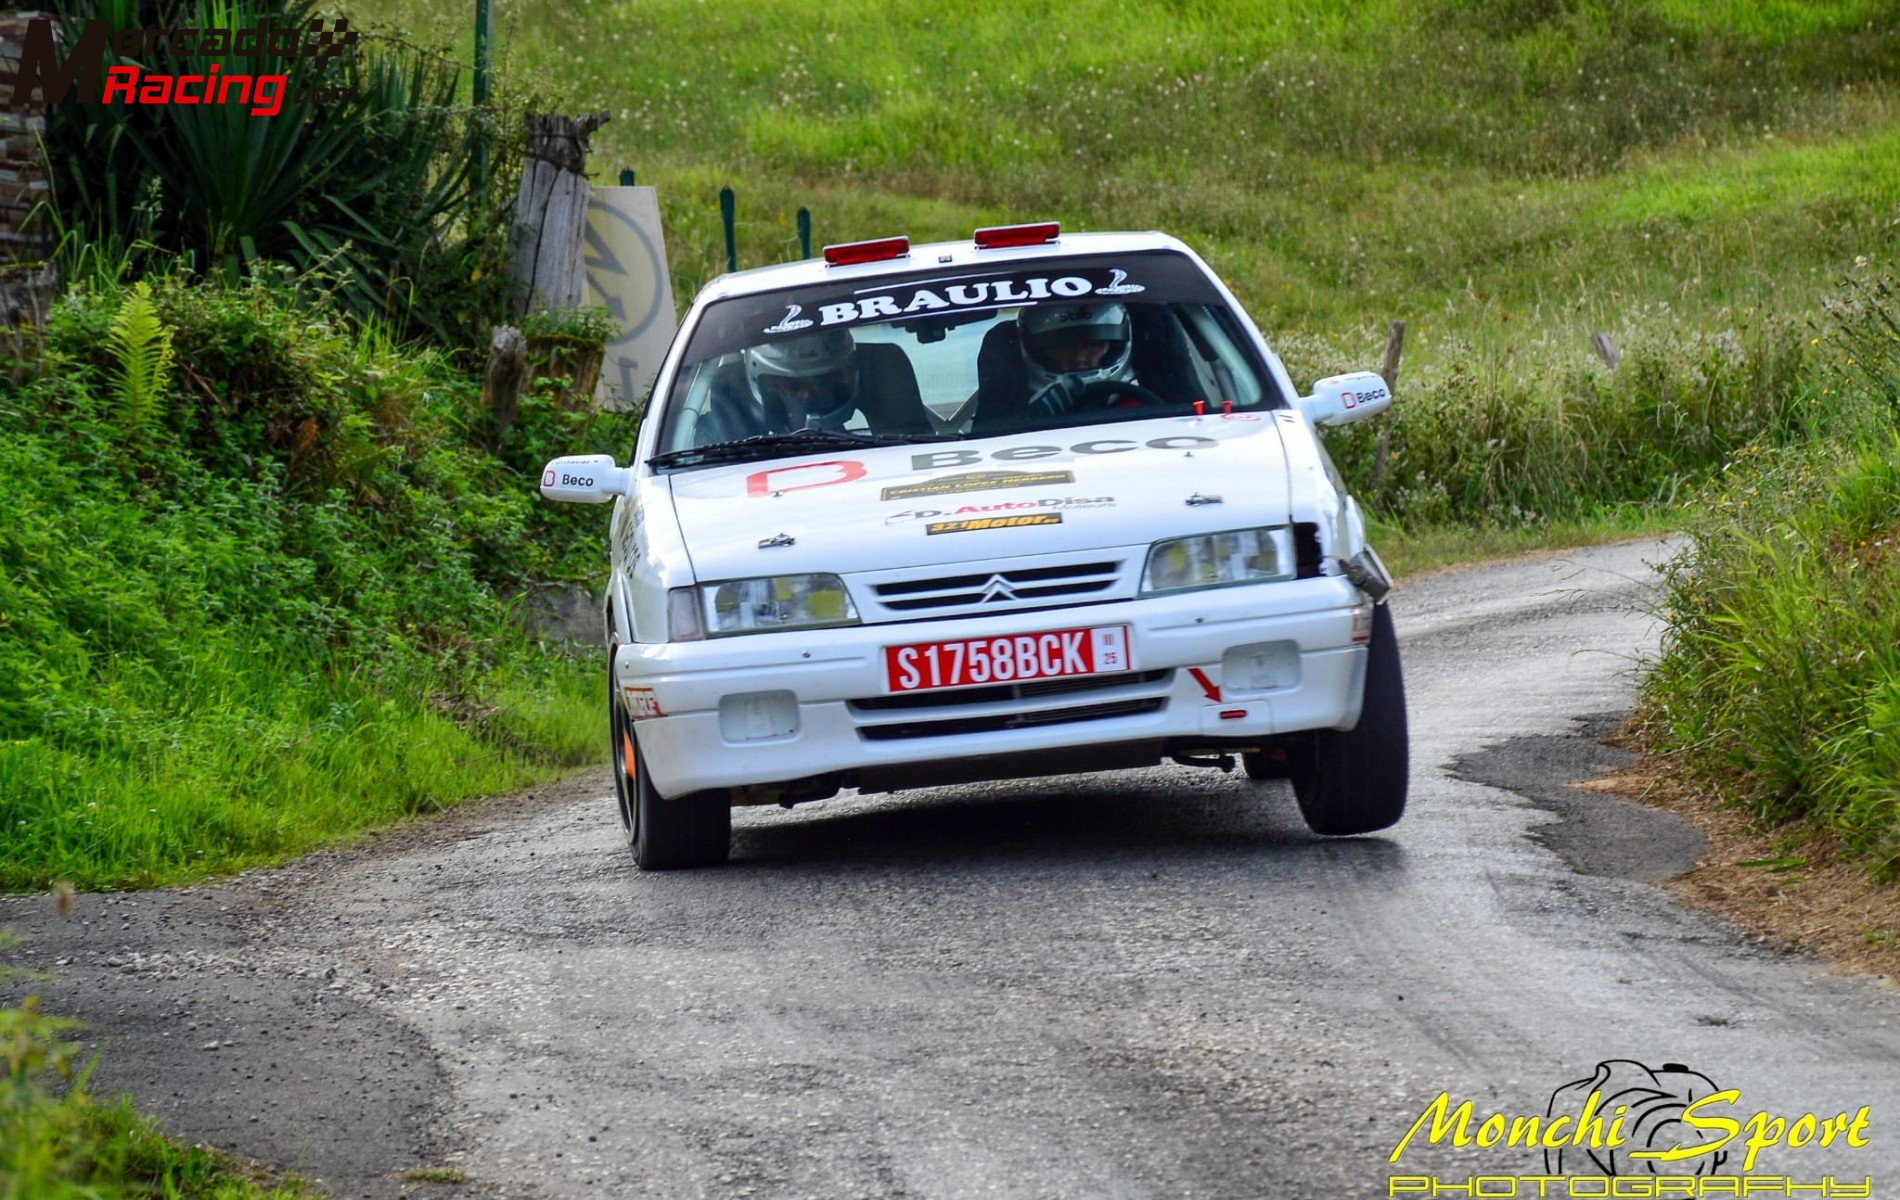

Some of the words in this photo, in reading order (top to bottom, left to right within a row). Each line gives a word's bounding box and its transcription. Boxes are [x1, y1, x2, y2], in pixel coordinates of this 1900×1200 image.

[819, 276, 1093, 326] BRAULIO
[1356, 388, 1386, 403] Beco
[911, 436, 1219, 471] Beco
[562, 474, 594, 487] Beco
[898, 631, 1088, 690] S1758BCK
